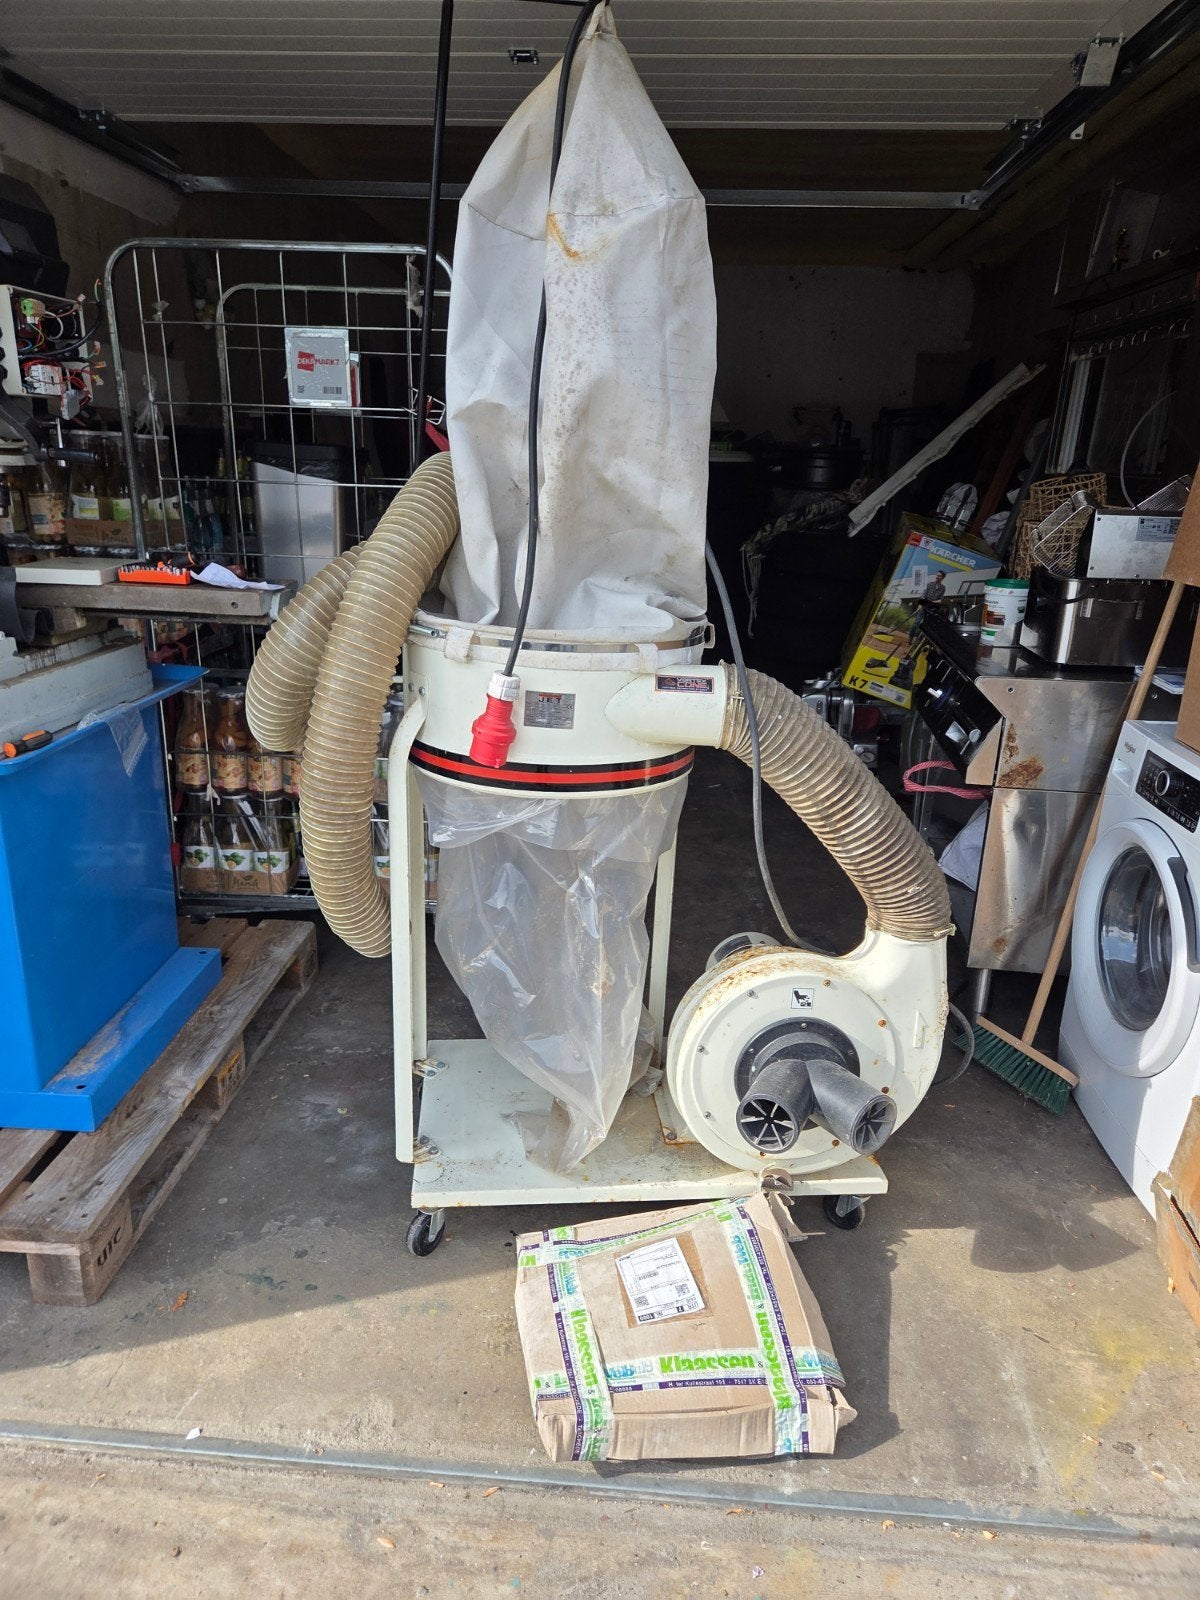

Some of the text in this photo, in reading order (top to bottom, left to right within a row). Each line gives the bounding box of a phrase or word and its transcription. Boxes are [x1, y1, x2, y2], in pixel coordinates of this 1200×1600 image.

[849, 675, 860, 686] K
[859, 679, 869, 689] 7
[570, 1309, 599, 1387] Klaassen
[658, 1354, 755, 1374] Klaassen
[755, 1312, 793, 1410] Klaassen
